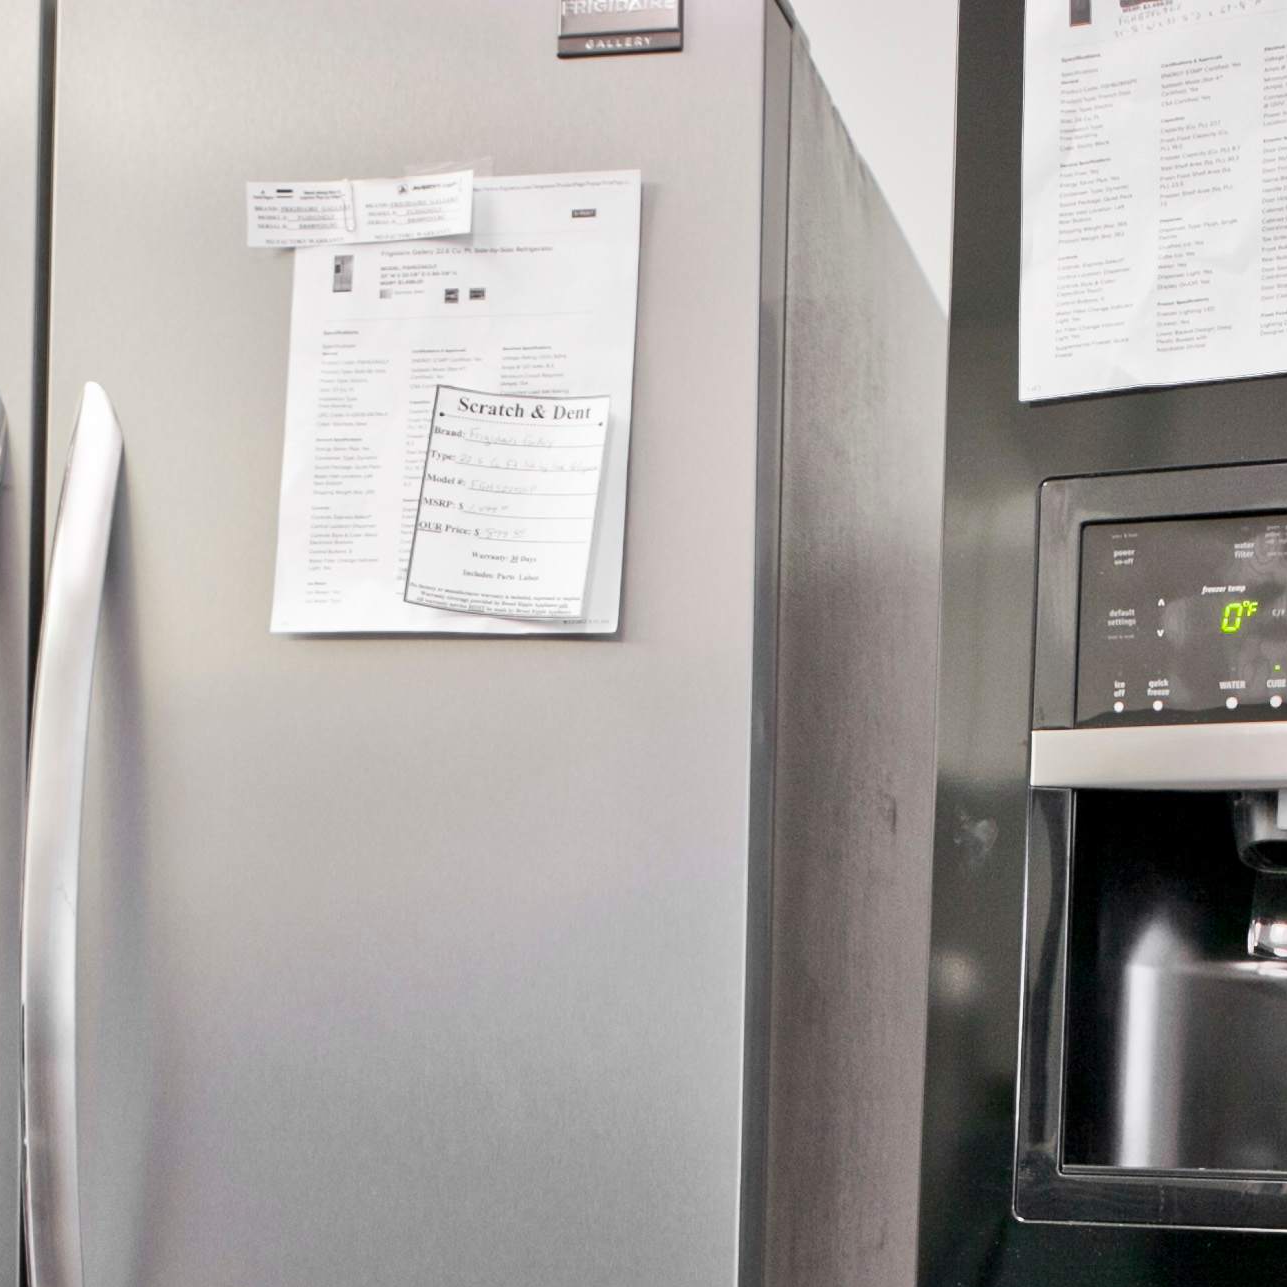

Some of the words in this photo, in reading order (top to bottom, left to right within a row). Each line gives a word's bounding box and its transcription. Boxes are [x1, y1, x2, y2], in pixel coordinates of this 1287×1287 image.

[585, 36, 652, 49] GALLERY
[457, 396, 524, 418] Scratch
[531, 404, 545, 420] &
[553, 405, 591, 420] Dent
[434, 426, 465, 437] Brand:
[431, 450, 457, 462] Type:
[426, 472, 456, 486] Model
[445, 524, 472, 536] Price:
[1114, 550, 1134, 558] power
[1234, 551, 1254, 559] filter
[1201, 586, 1226, 595] freezer
[1228, 585, 1246, 593] temp
[1109, 608, 1135, 618] default
[1148, 679, 1169, 689] quick
[1219, 680, 1246, 690] WATER
[1266, 679, 1287, 688] CUBE
[1114, 689, 1126, 698] off
